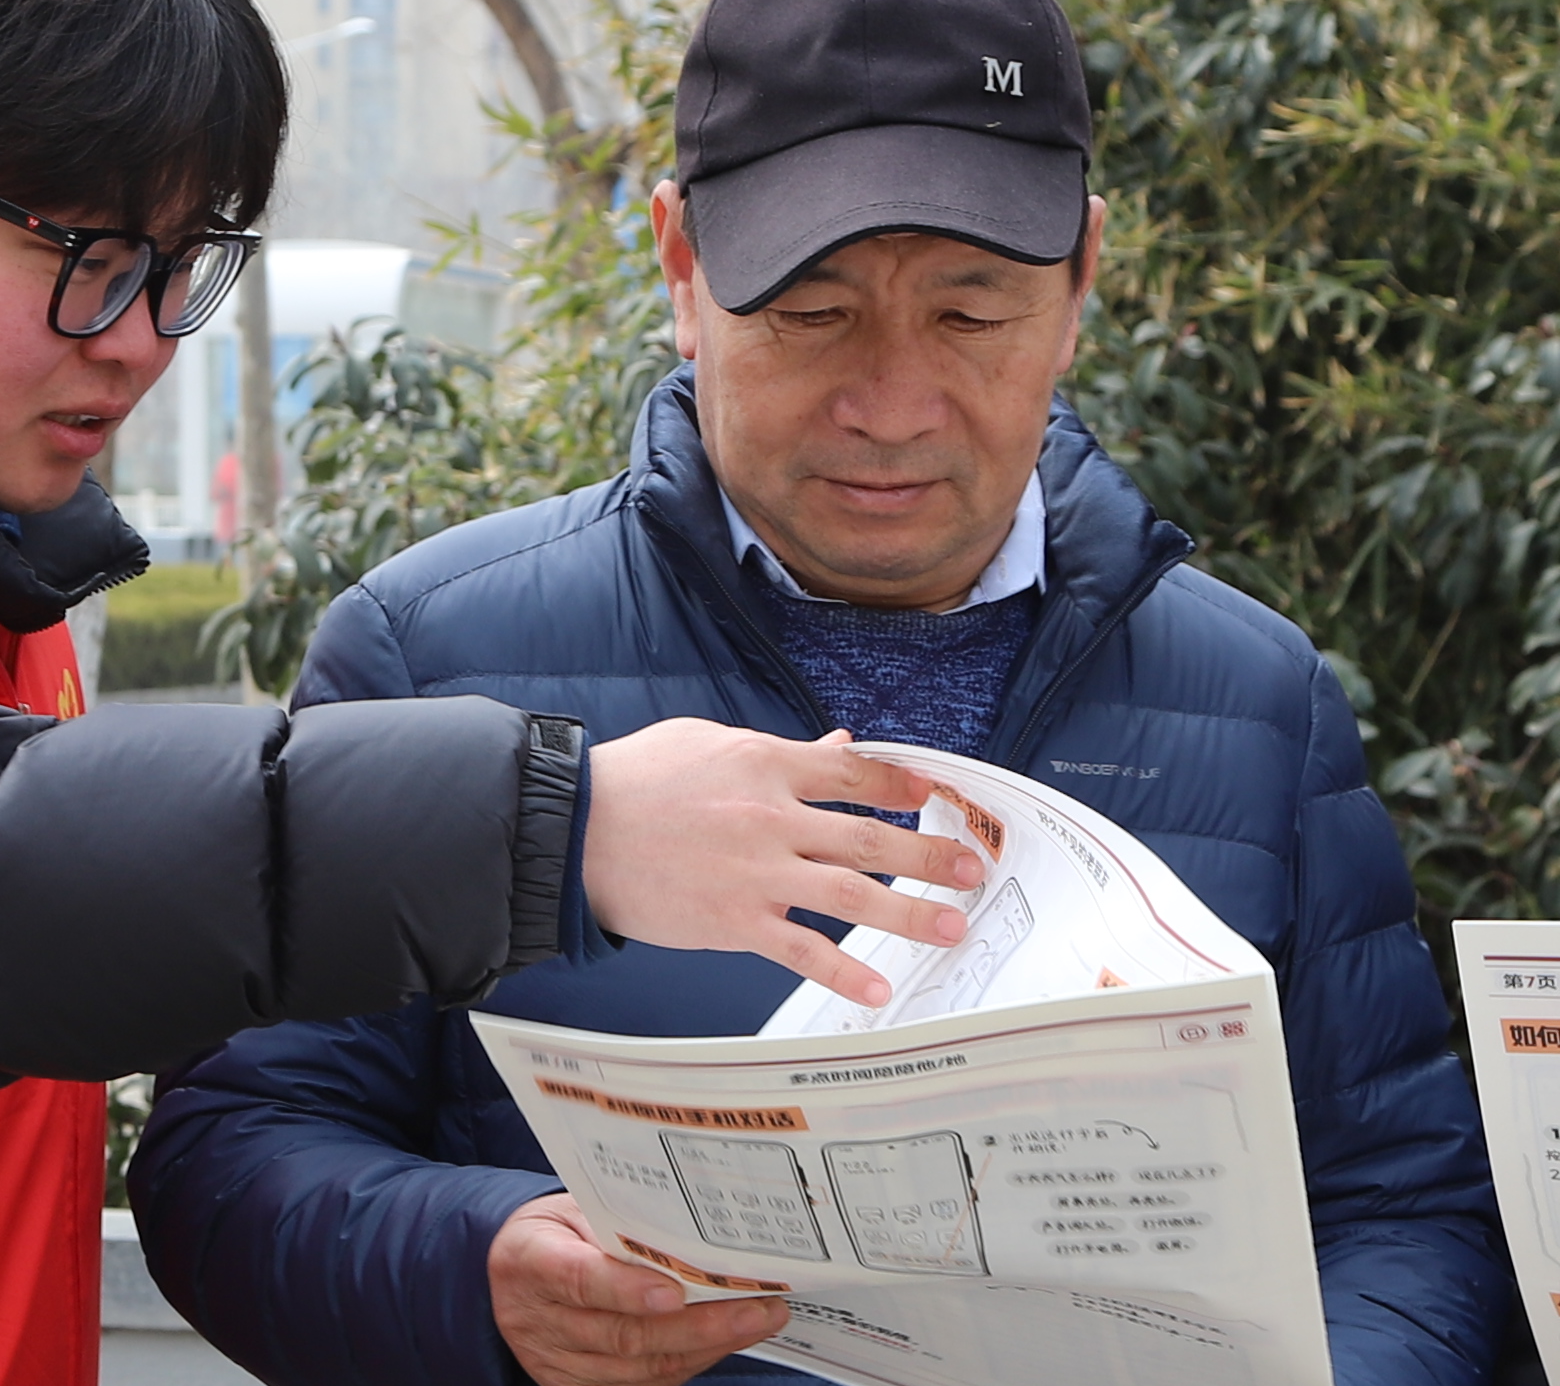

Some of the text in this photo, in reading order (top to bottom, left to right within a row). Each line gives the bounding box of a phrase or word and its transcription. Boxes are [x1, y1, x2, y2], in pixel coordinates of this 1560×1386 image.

[981, 56, 1024, 96] M
[1503, 974, 1557, 990] 第7页
[1551, 1128, 1560, 1140] 1
